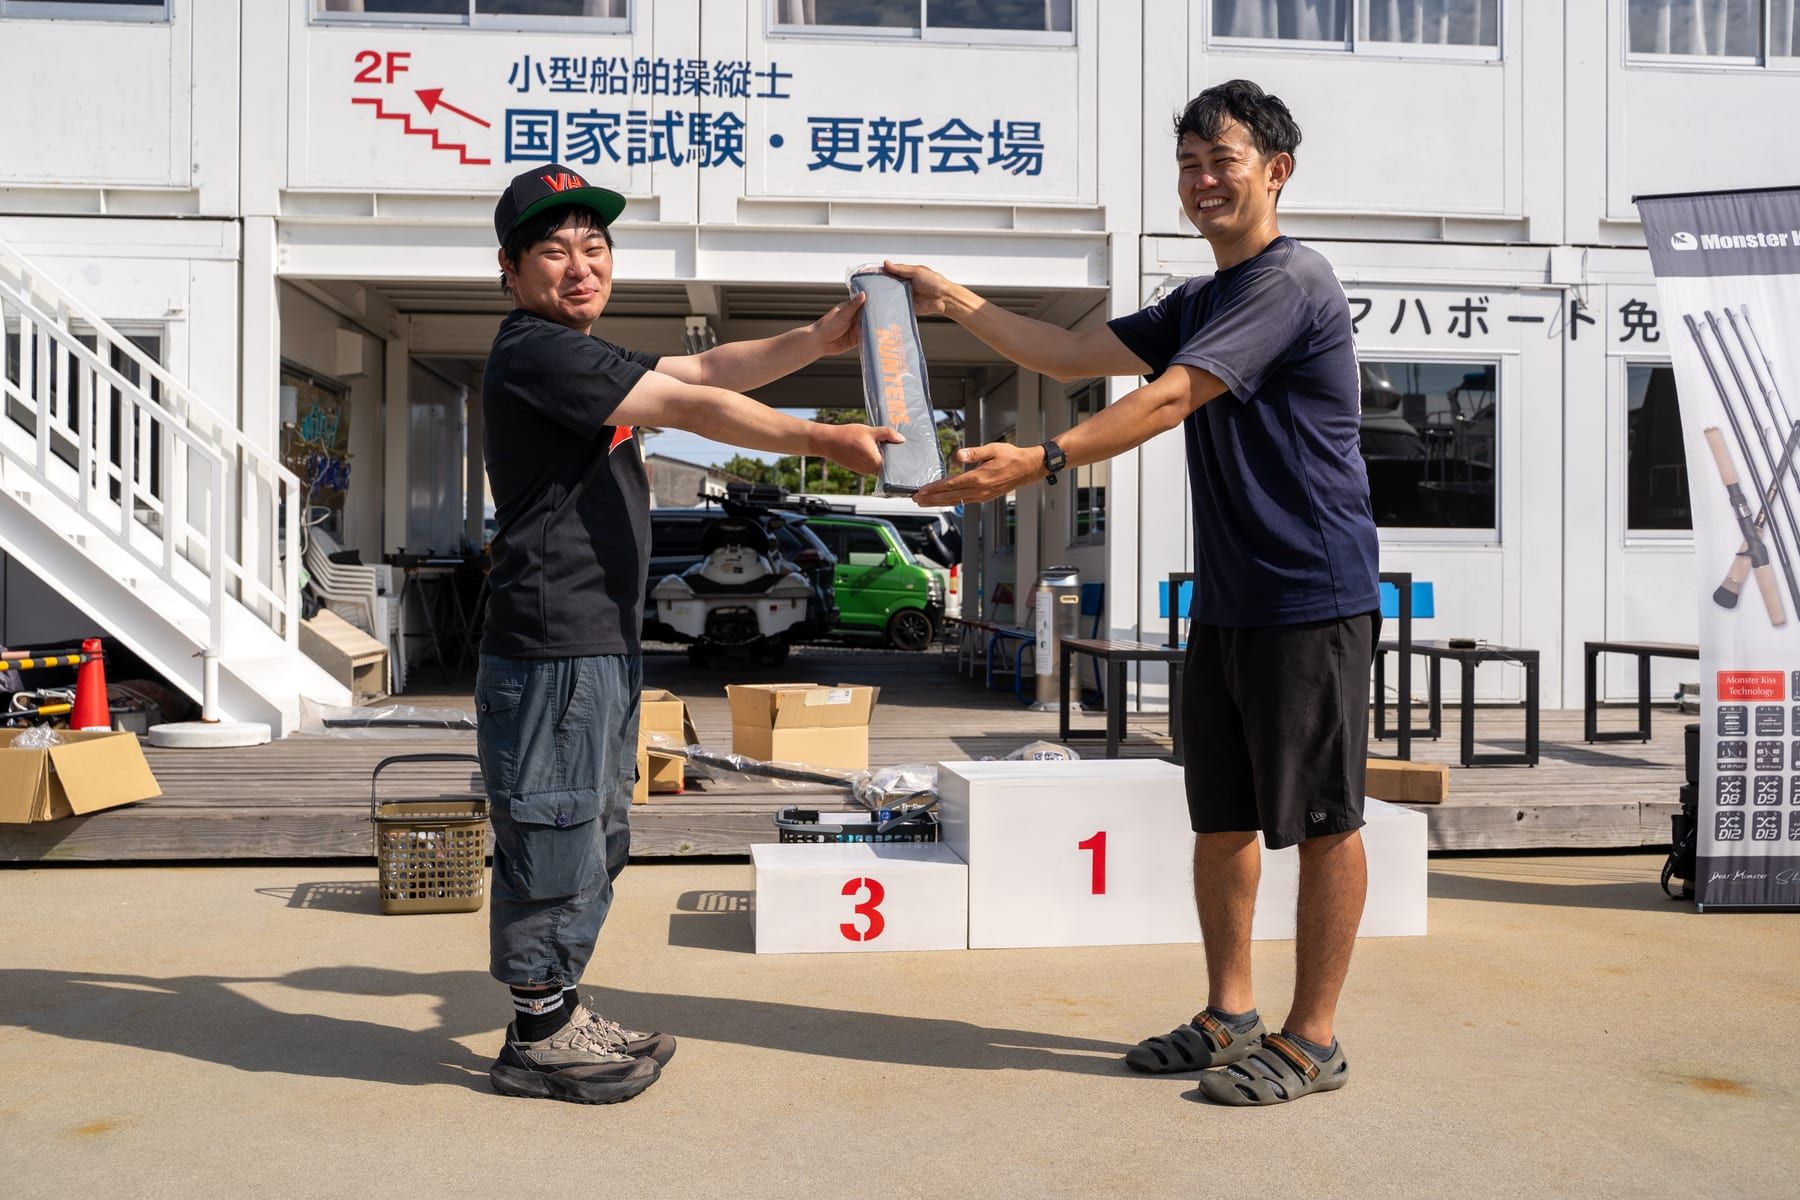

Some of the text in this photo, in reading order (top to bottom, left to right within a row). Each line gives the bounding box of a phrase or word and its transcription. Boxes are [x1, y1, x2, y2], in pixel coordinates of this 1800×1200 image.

[354, 51, 411, 84] 2F
[507, 56, 793, 100] 小型船舶操縦士
[504, 108, 1044, 176] 国家試験・更新会場
[1700, 232, 1789, 250] Monster
[1726, 676, 1777, 684] Monster Kiss
[1728, 687, 1775, 697] Technology
[1719, 794, 1741, 805] D8
[1757, 794, 1777, 805] D9
[1078, 831, 1107, 895] 1
[1708, 869, 1768, 883] Dear Monster
[840, 877, 886, 942] 3
